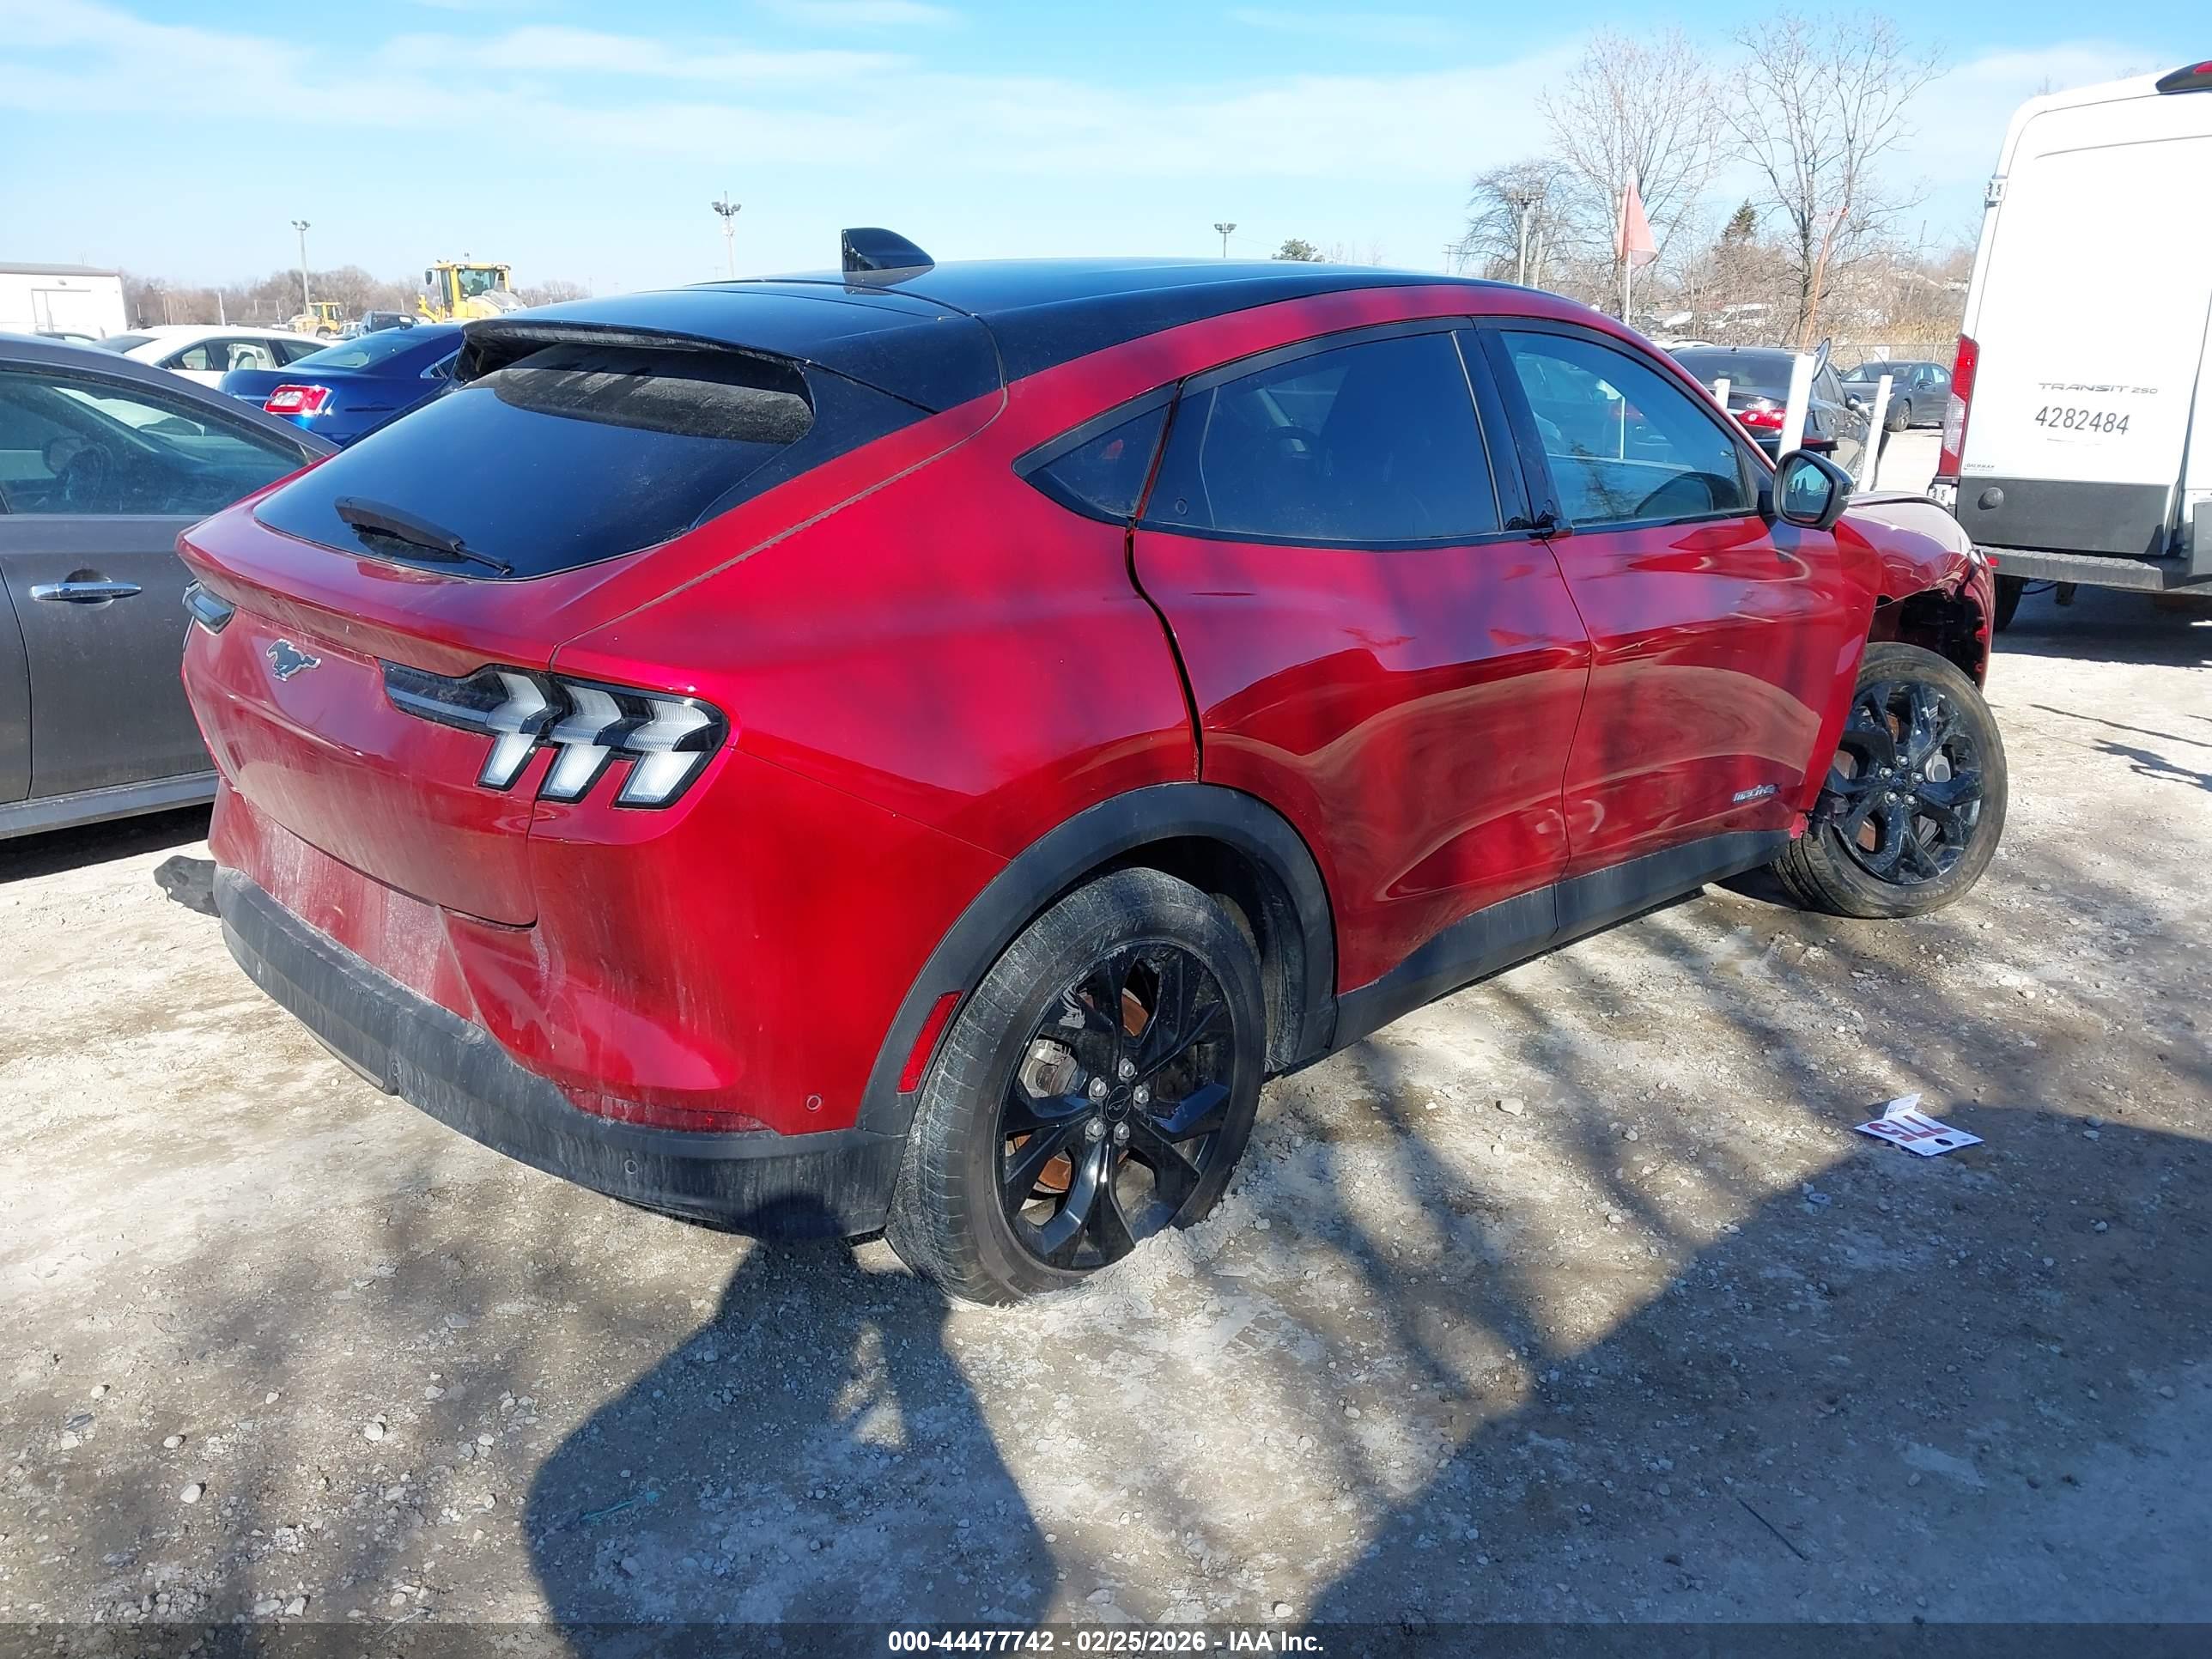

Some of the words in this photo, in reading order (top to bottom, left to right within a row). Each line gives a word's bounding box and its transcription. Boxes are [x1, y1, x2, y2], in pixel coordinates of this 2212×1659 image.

[2038, 382, 2130, 393] TRANSIT
[2130, 386, 2159, 395] 250
[2034, 405, 2130, 435] 4282484
